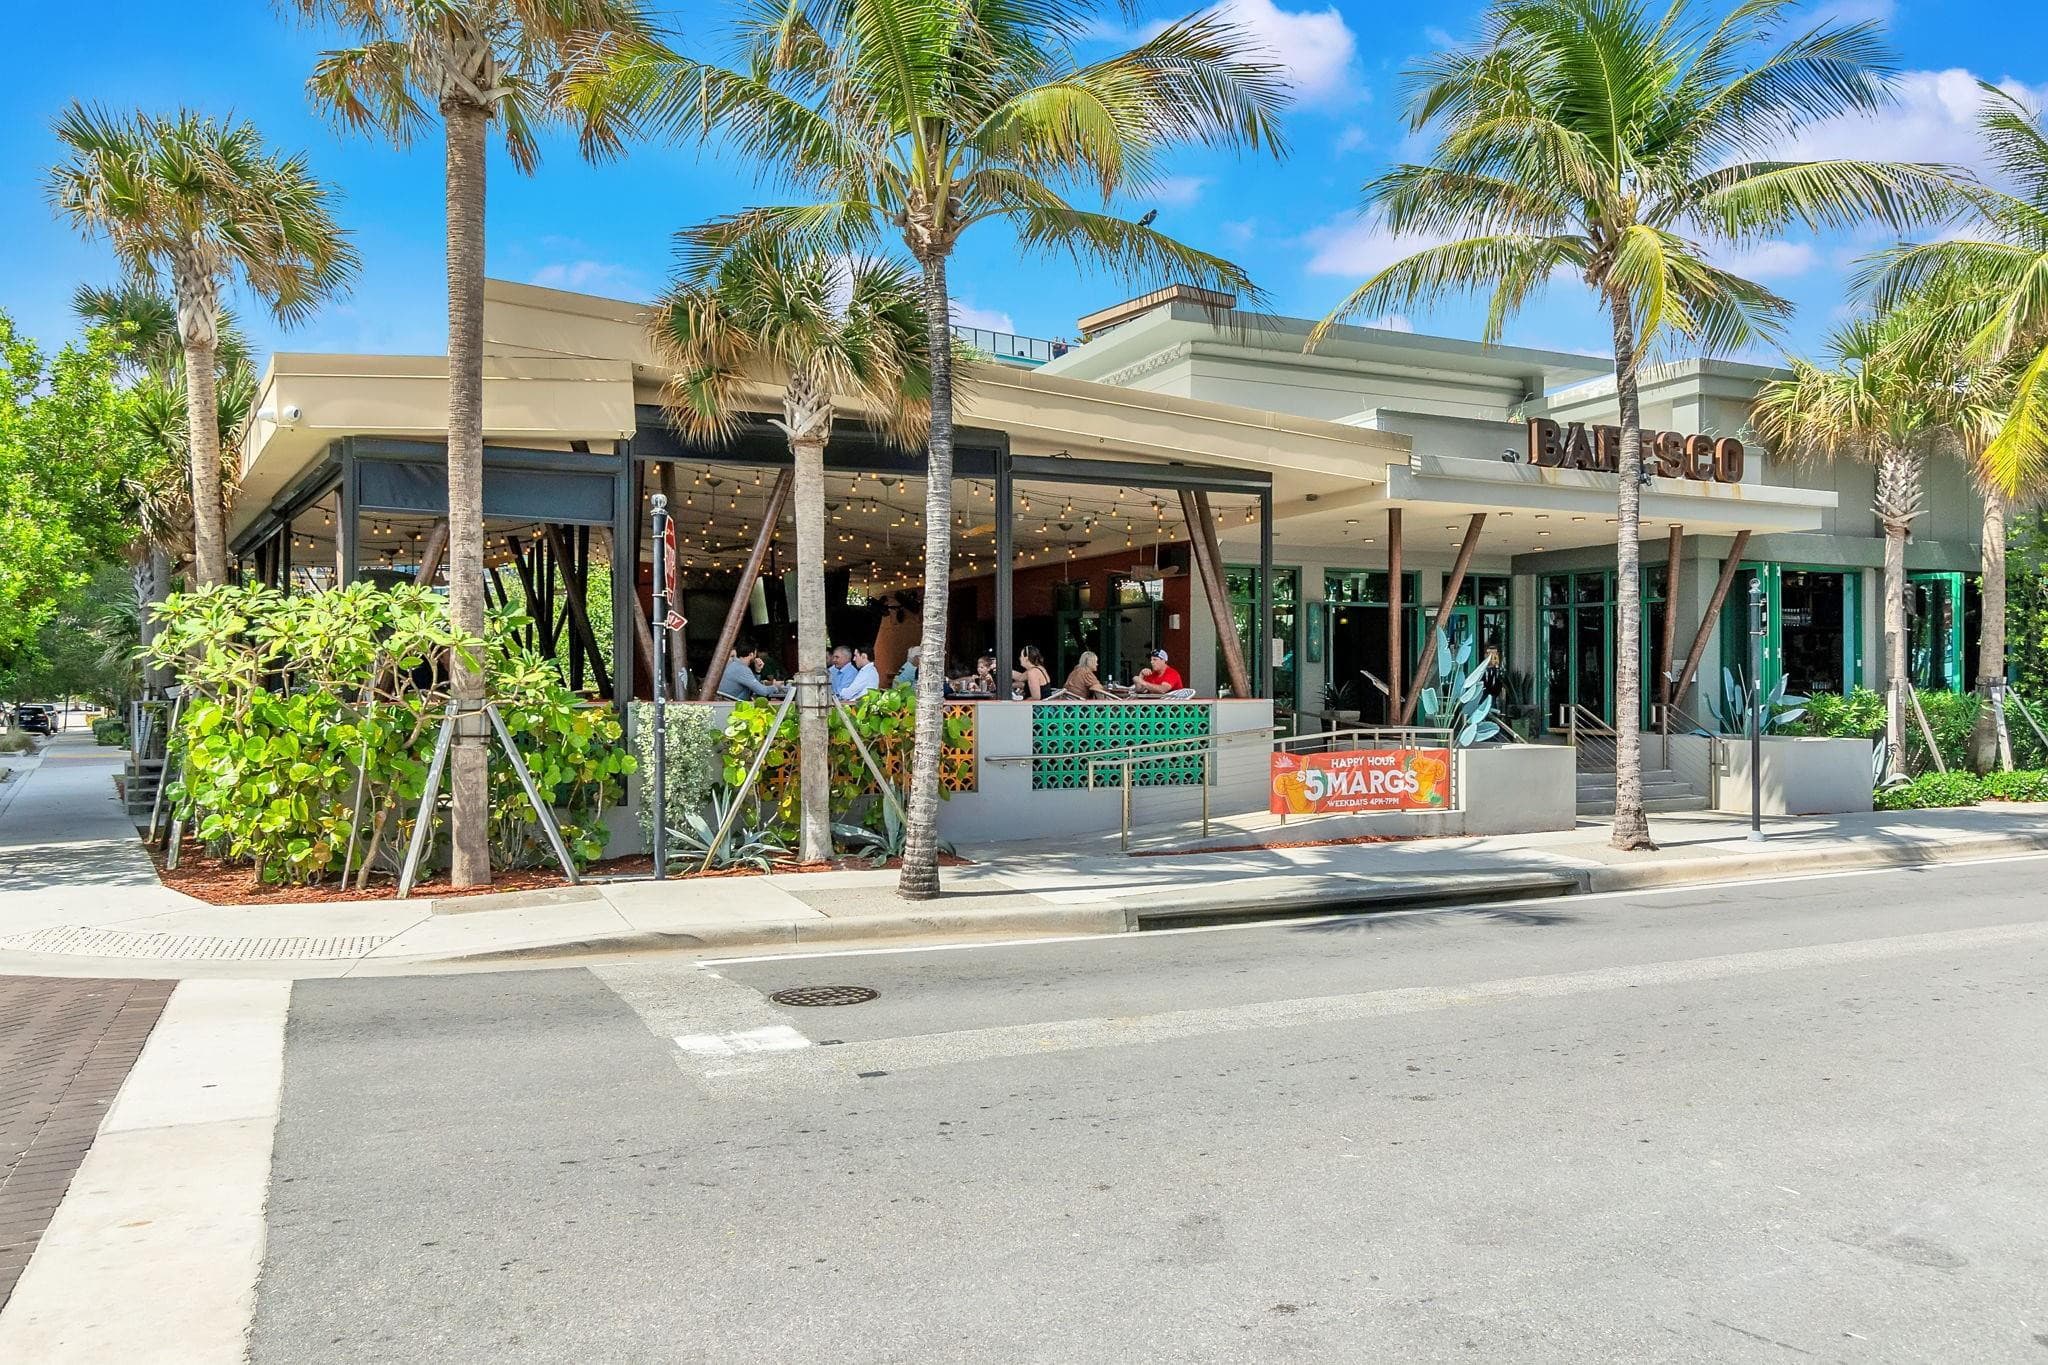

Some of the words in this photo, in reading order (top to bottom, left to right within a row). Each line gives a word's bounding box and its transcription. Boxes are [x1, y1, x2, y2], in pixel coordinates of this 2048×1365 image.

[1331, 757, 1363, 768] HAPPY
[1367, 756, 1396, 766] HOUR
[1326, 769, 1419, 796] MARGS
[1327, 799, 1368, 807] WEEKDAYS
[1369, 797, 1399, 806] 4PM-7PM
